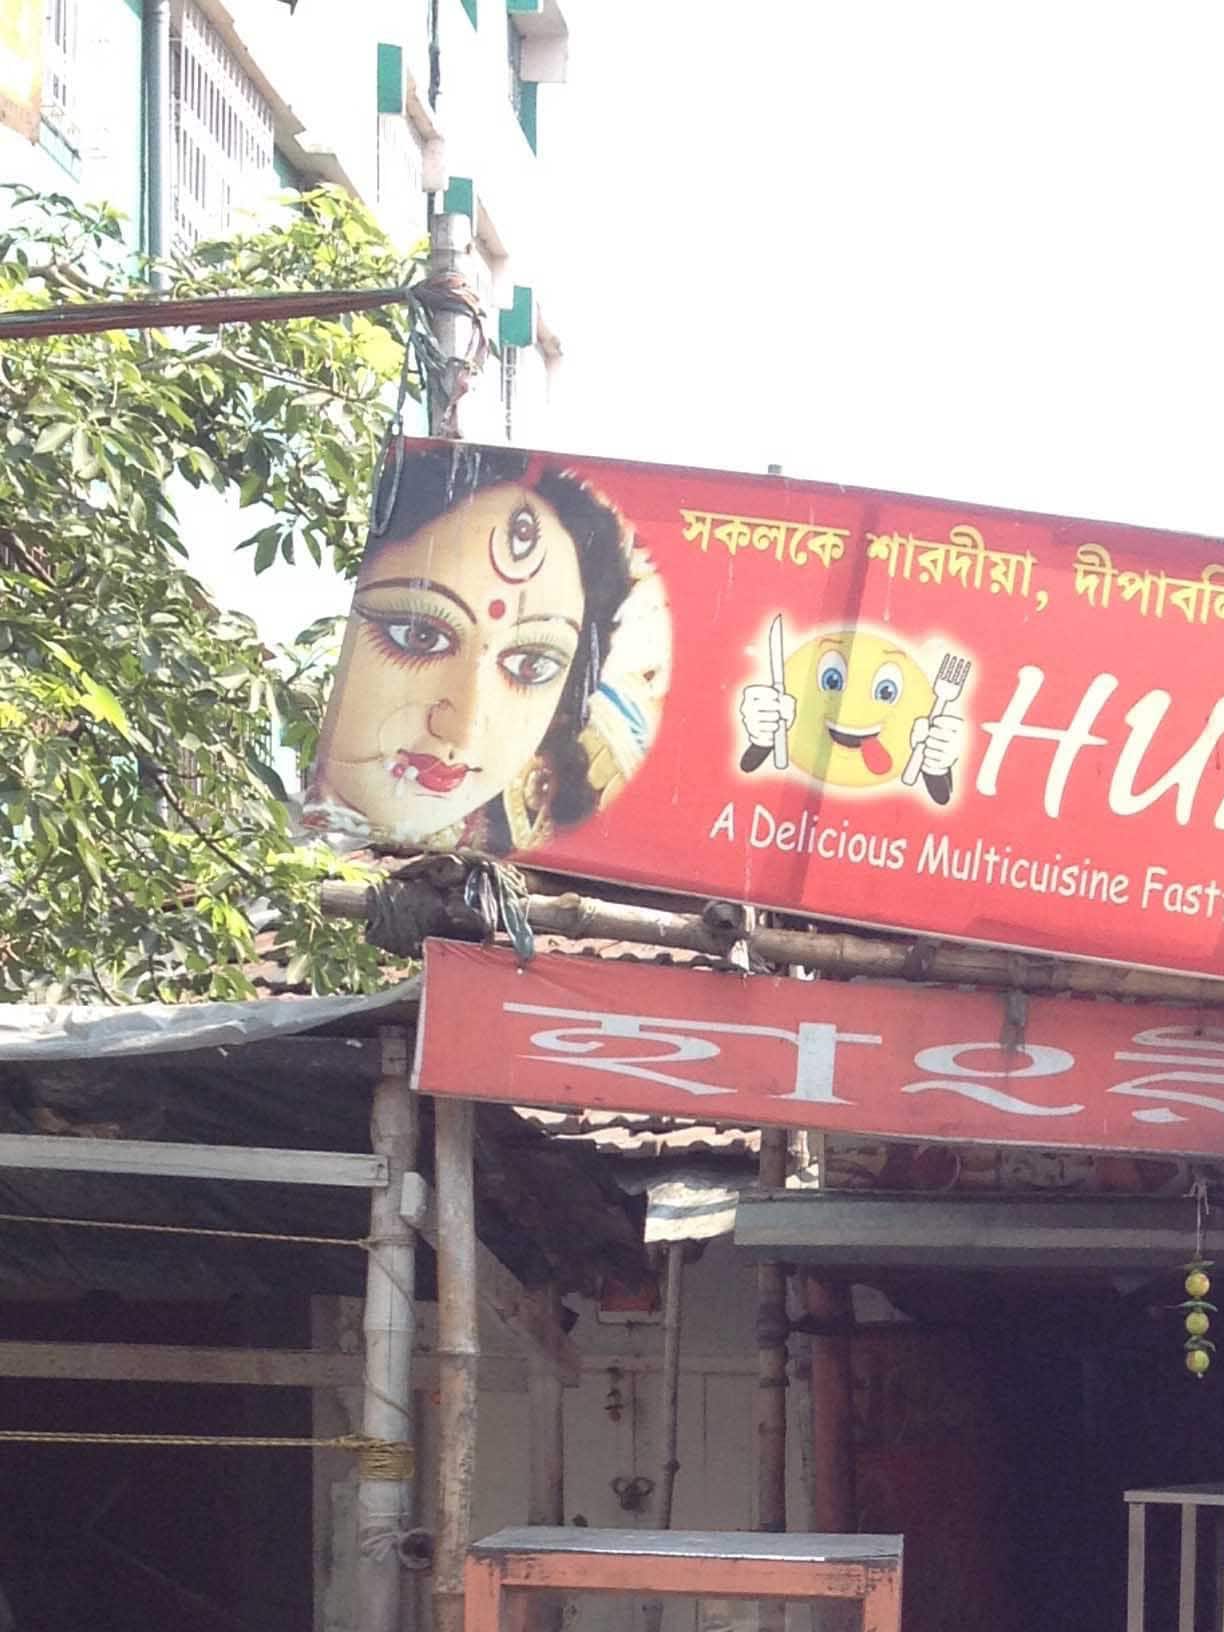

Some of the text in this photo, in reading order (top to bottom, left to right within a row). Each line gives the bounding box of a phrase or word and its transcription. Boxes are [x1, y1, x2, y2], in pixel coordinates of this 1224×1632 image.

[680, 508, 850, 568] সকলকে
[866, 525, 1050, 612] শারদীয়া,
[709, 802, 736, 842] A
[748, 804, 908, 870] Delicious
[916, 832, 1130, 905] Multicuisine
